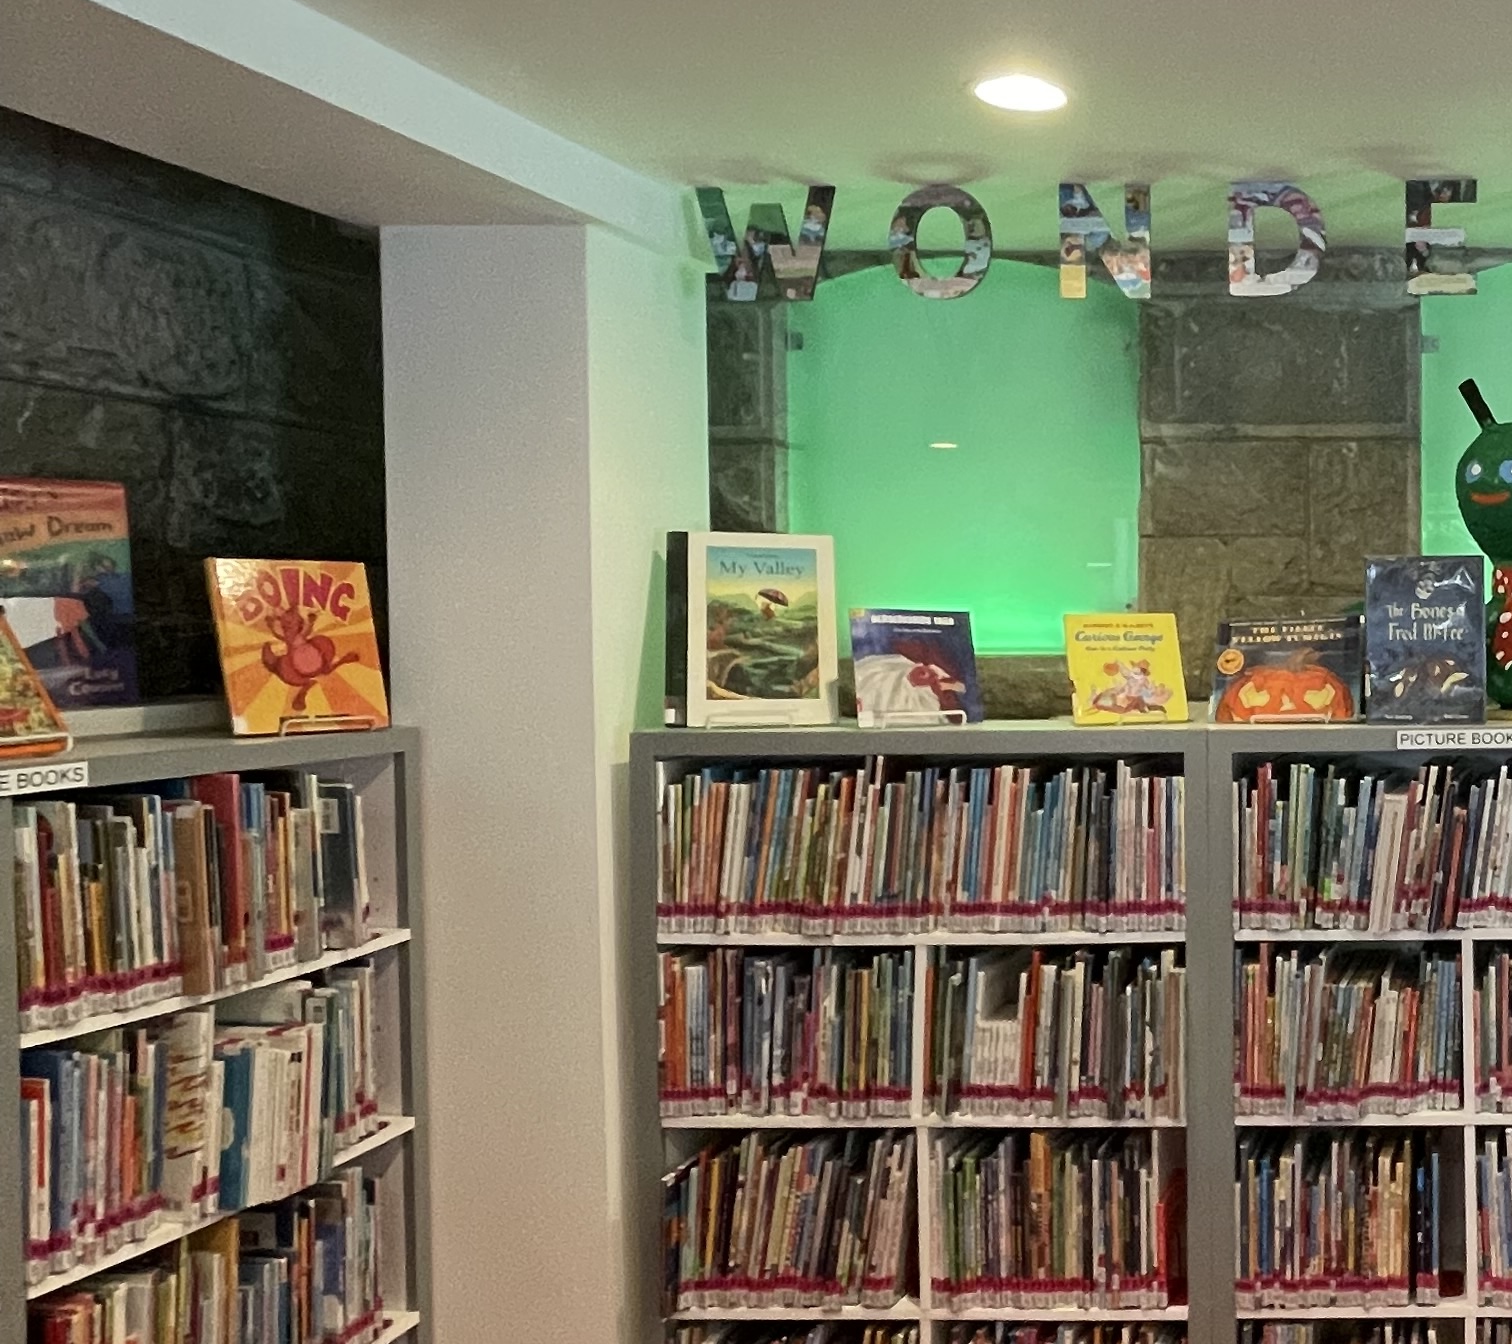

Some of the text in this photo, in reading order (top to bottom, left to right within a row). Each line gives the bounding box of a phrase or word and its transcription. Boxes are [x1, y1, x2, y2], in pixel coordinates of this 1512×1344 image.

[47, 516, 113, 537] Dream
[720, 561, 805, 579] My Valley
[1400, 732, 1467, 746] PICTURE
[16, 767, 84, 789] BOOKS
